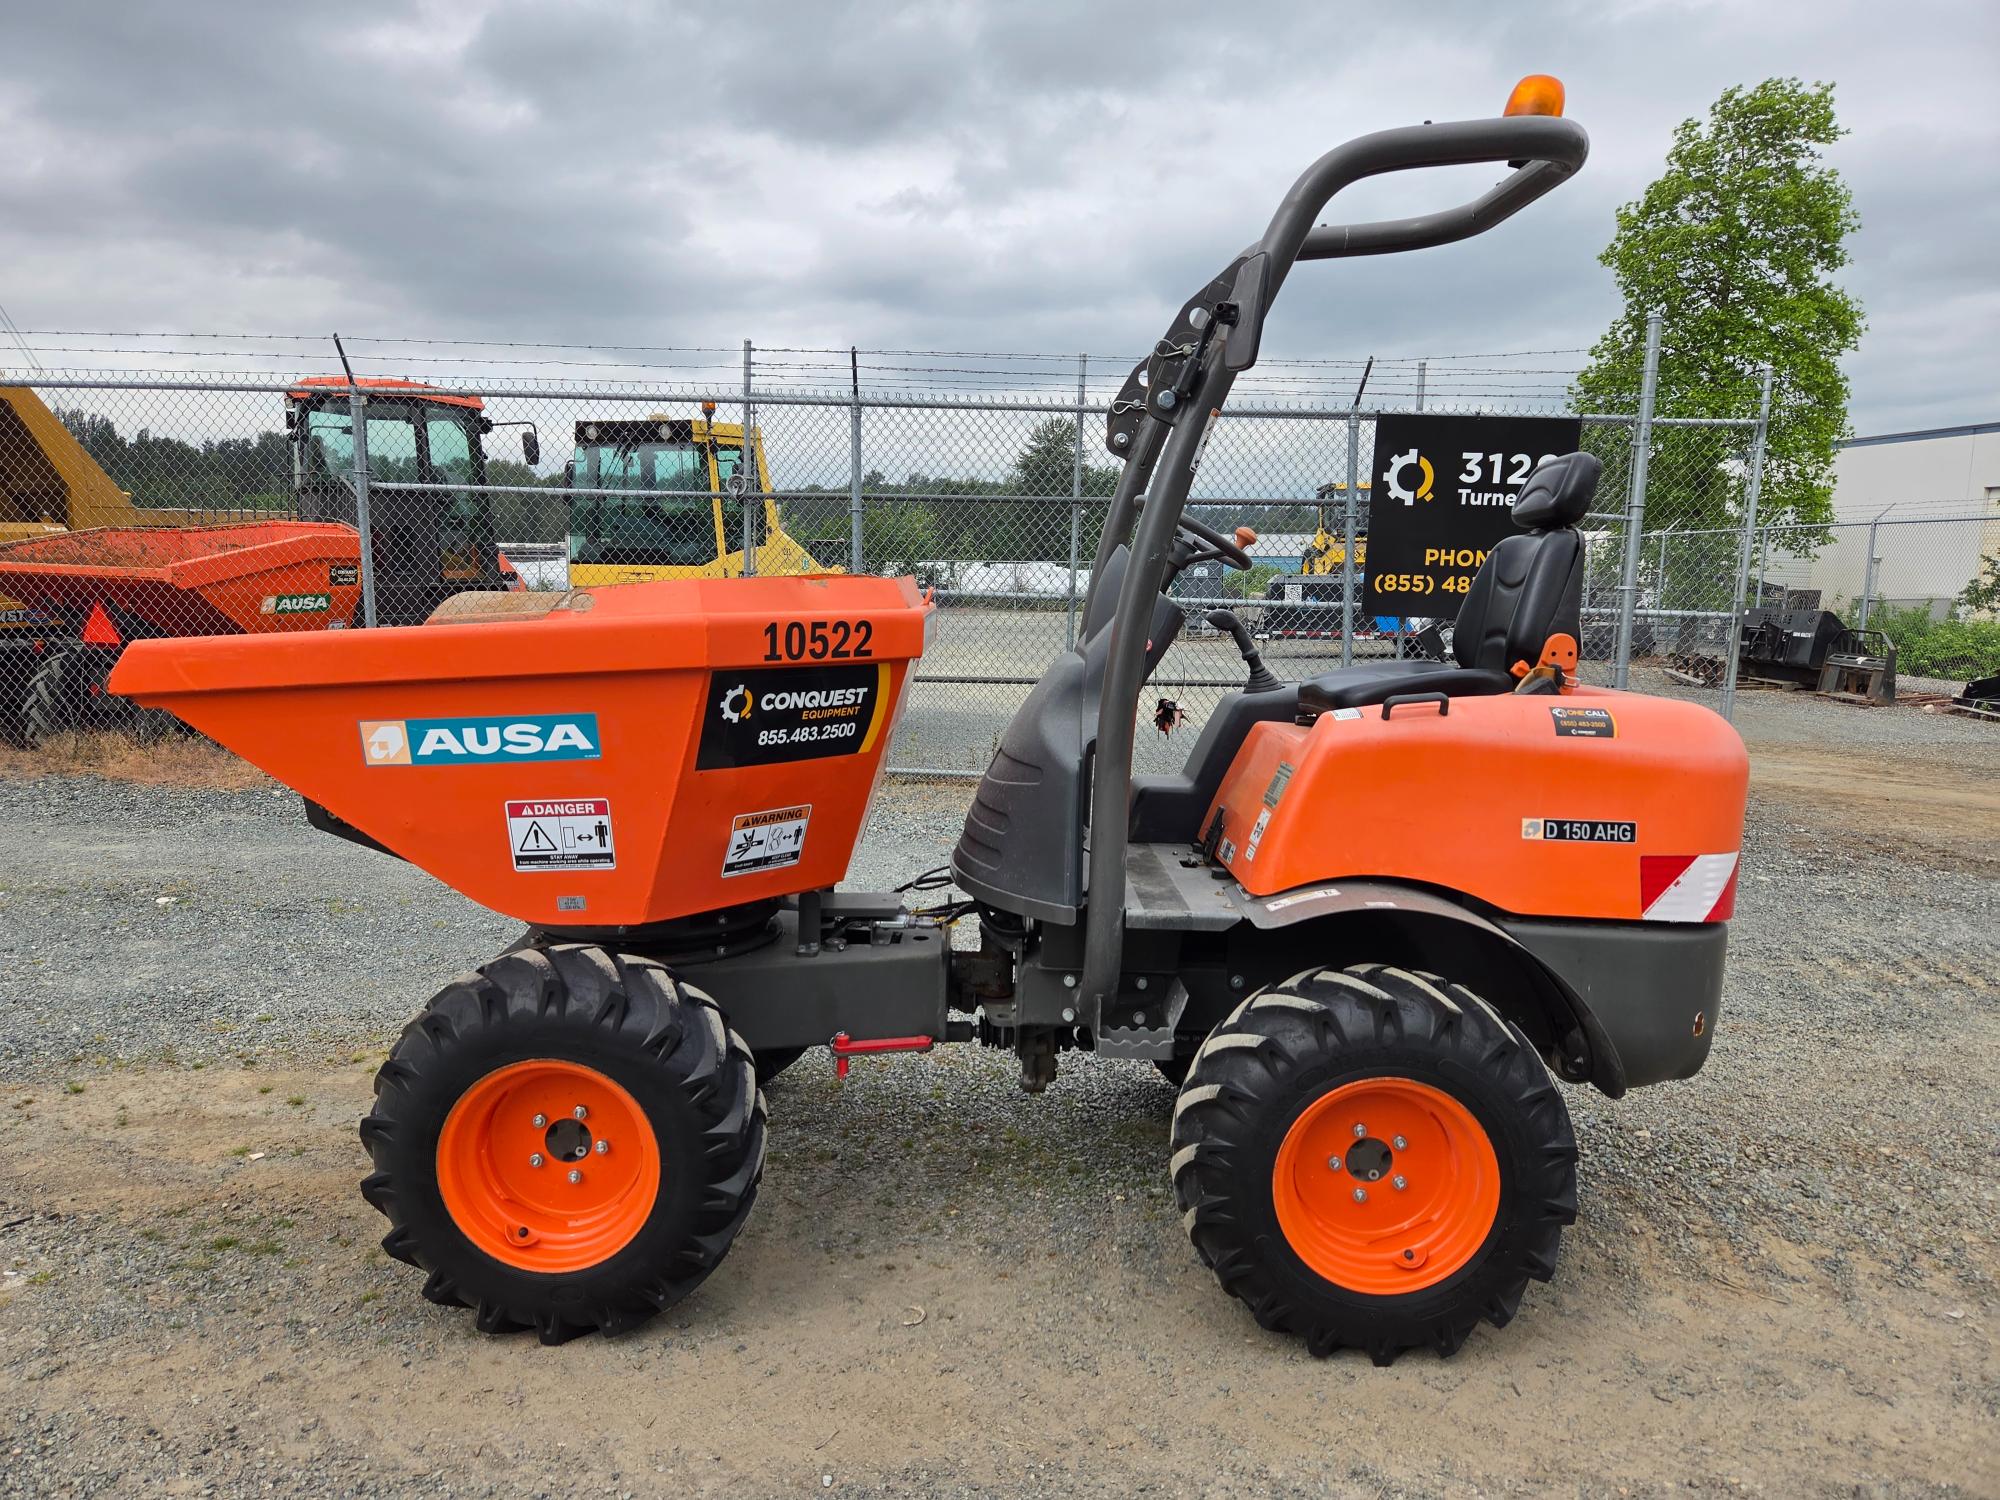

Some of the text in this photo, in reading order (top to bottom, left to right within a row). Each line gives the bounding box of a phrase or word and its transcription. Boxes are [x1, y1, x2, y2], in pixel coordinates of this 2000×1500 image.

[1374, 574, 1476, 595] (855) 48
[277, 597, 328, 610] AUSA
[764, 620, 873, 661] 10522
[761, 687, 868, 711] CONQUEST
[802, 706, 861, 720] EQUIPMENT
[417, 723, 594, 755] AUSA
[758, 722, 856, 746] 855.483.2500
[533, 803, 595, 815] DANGER
[751, 809, 803, 825] WARNING
[1545, 822, 1631, 841] D 150 AHG
